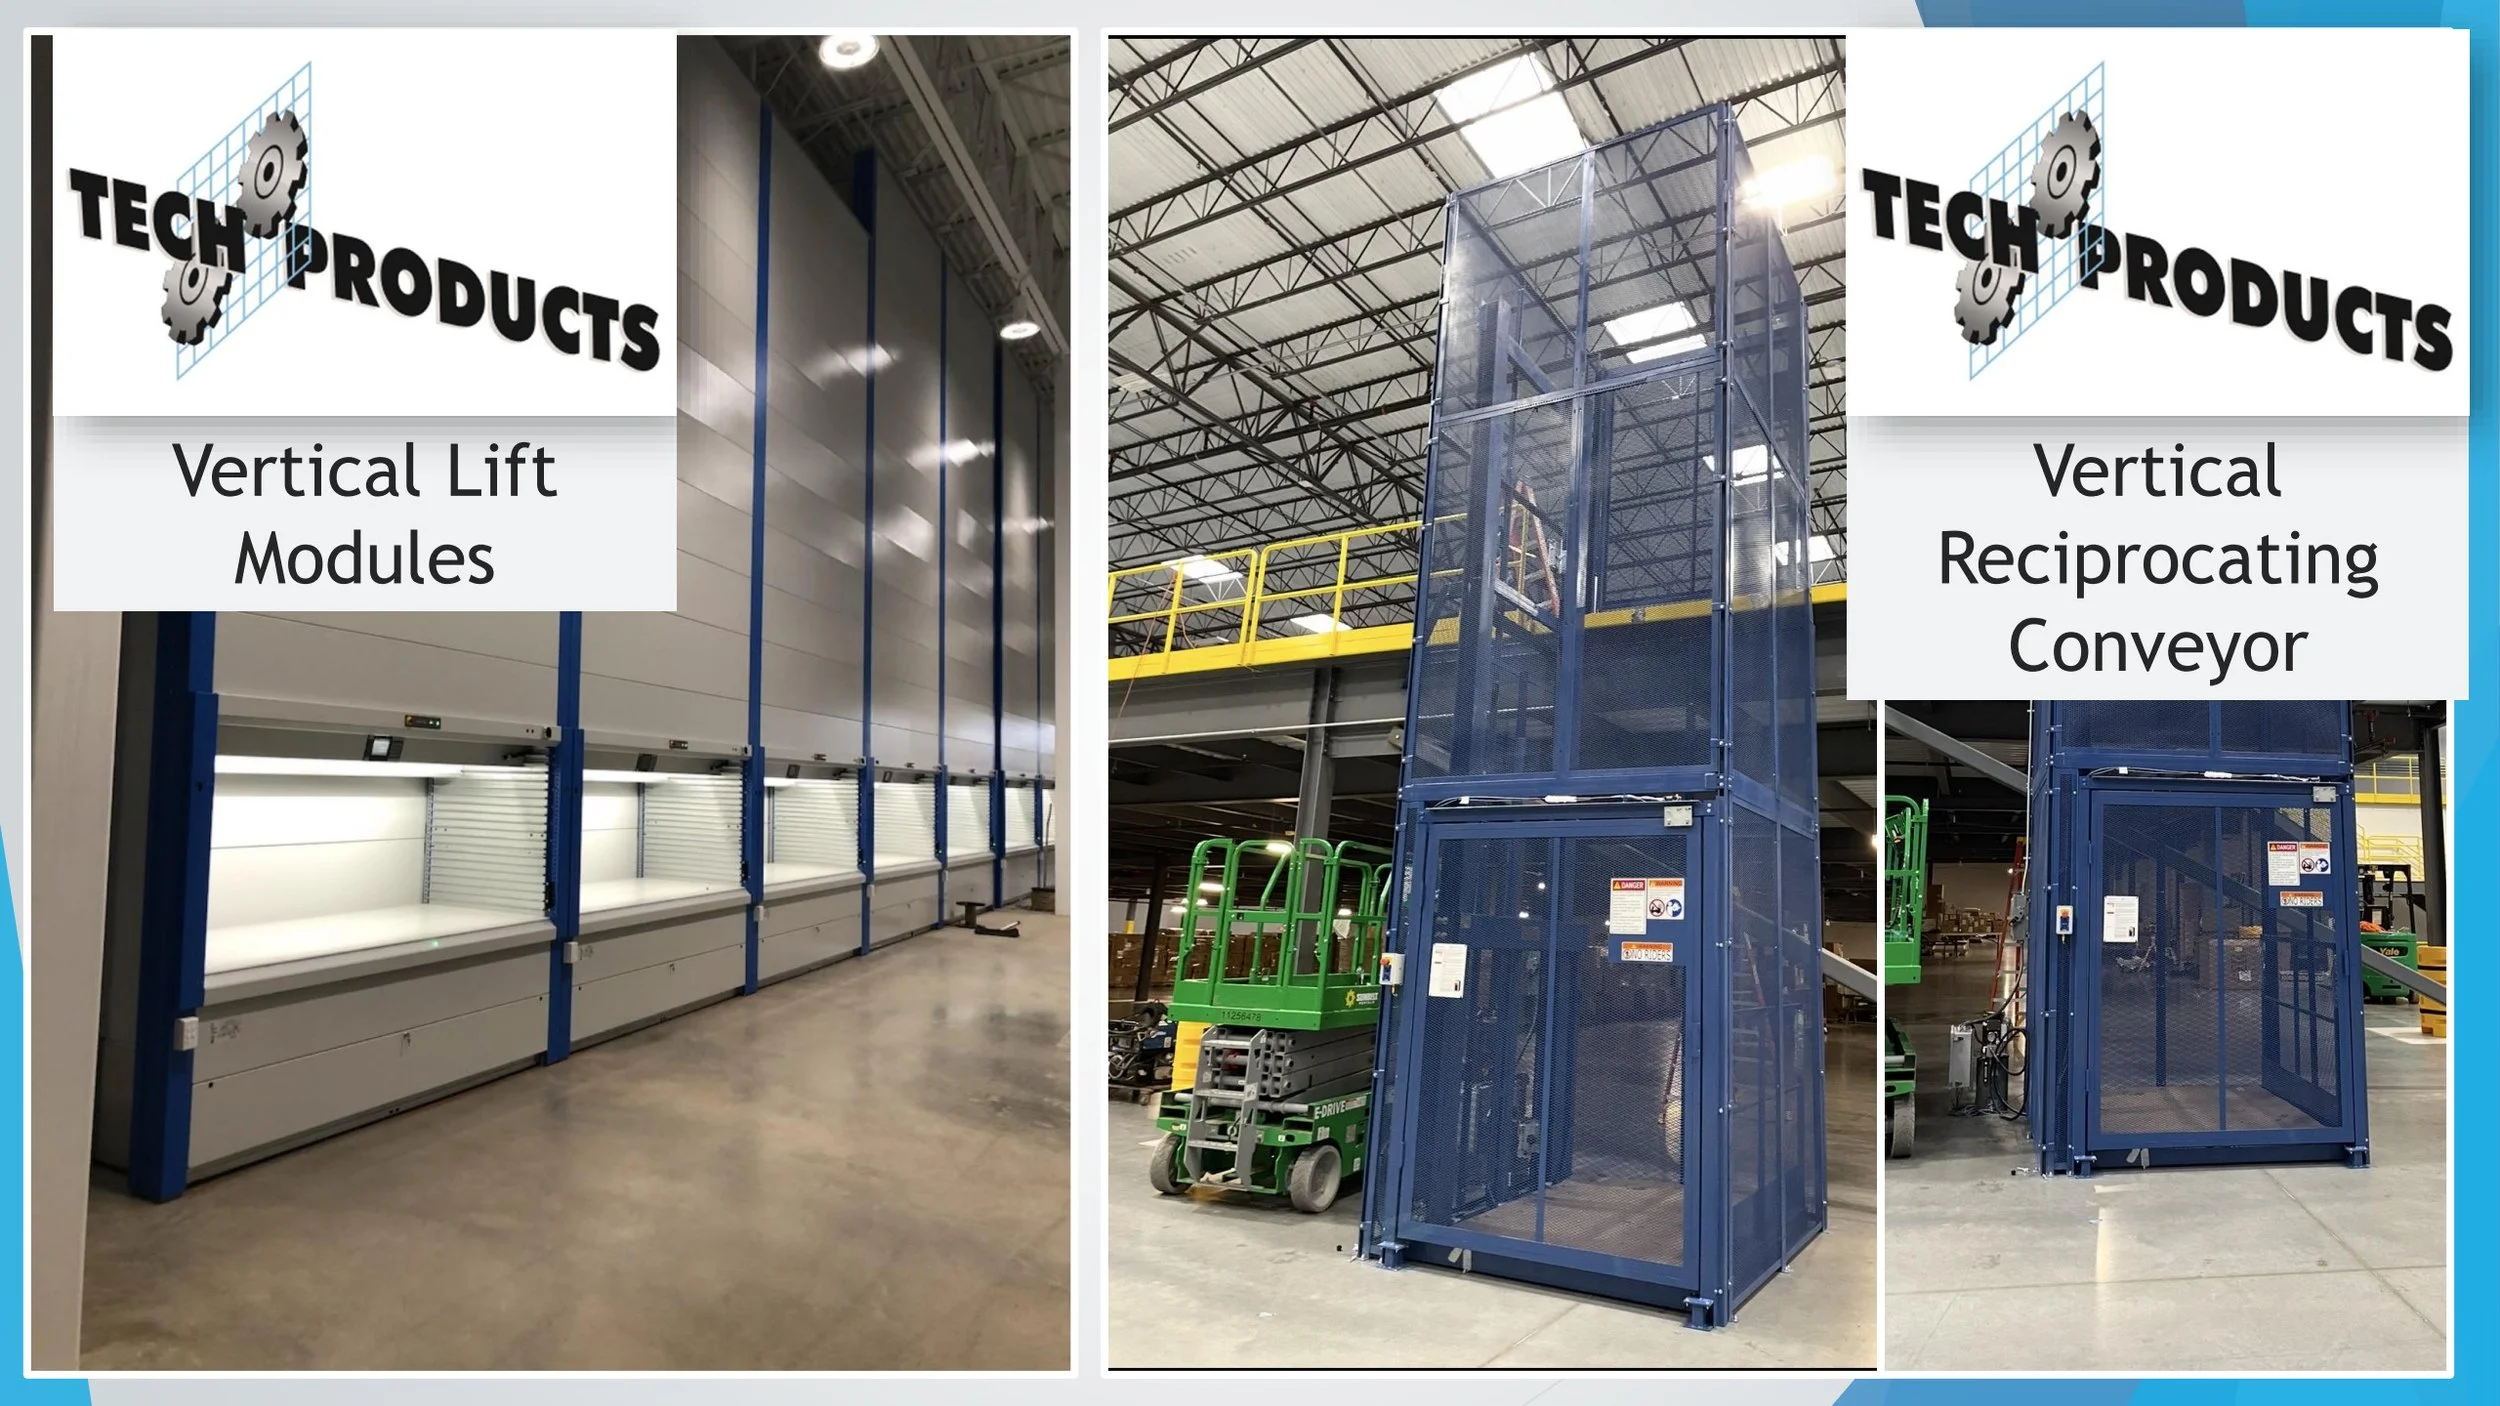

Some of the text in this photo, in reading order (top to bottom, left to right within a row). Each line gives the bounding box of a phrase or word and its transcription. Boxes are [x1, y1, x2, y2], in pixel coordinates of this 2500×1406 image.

[1621, 881, 1645, 889] DANGER
[1631, 949, 1672, 961] NO RIDERS
[2380, 947, 2400, 956] Yale
[1314, 1100, 1346, 1120] E-DRIVE
